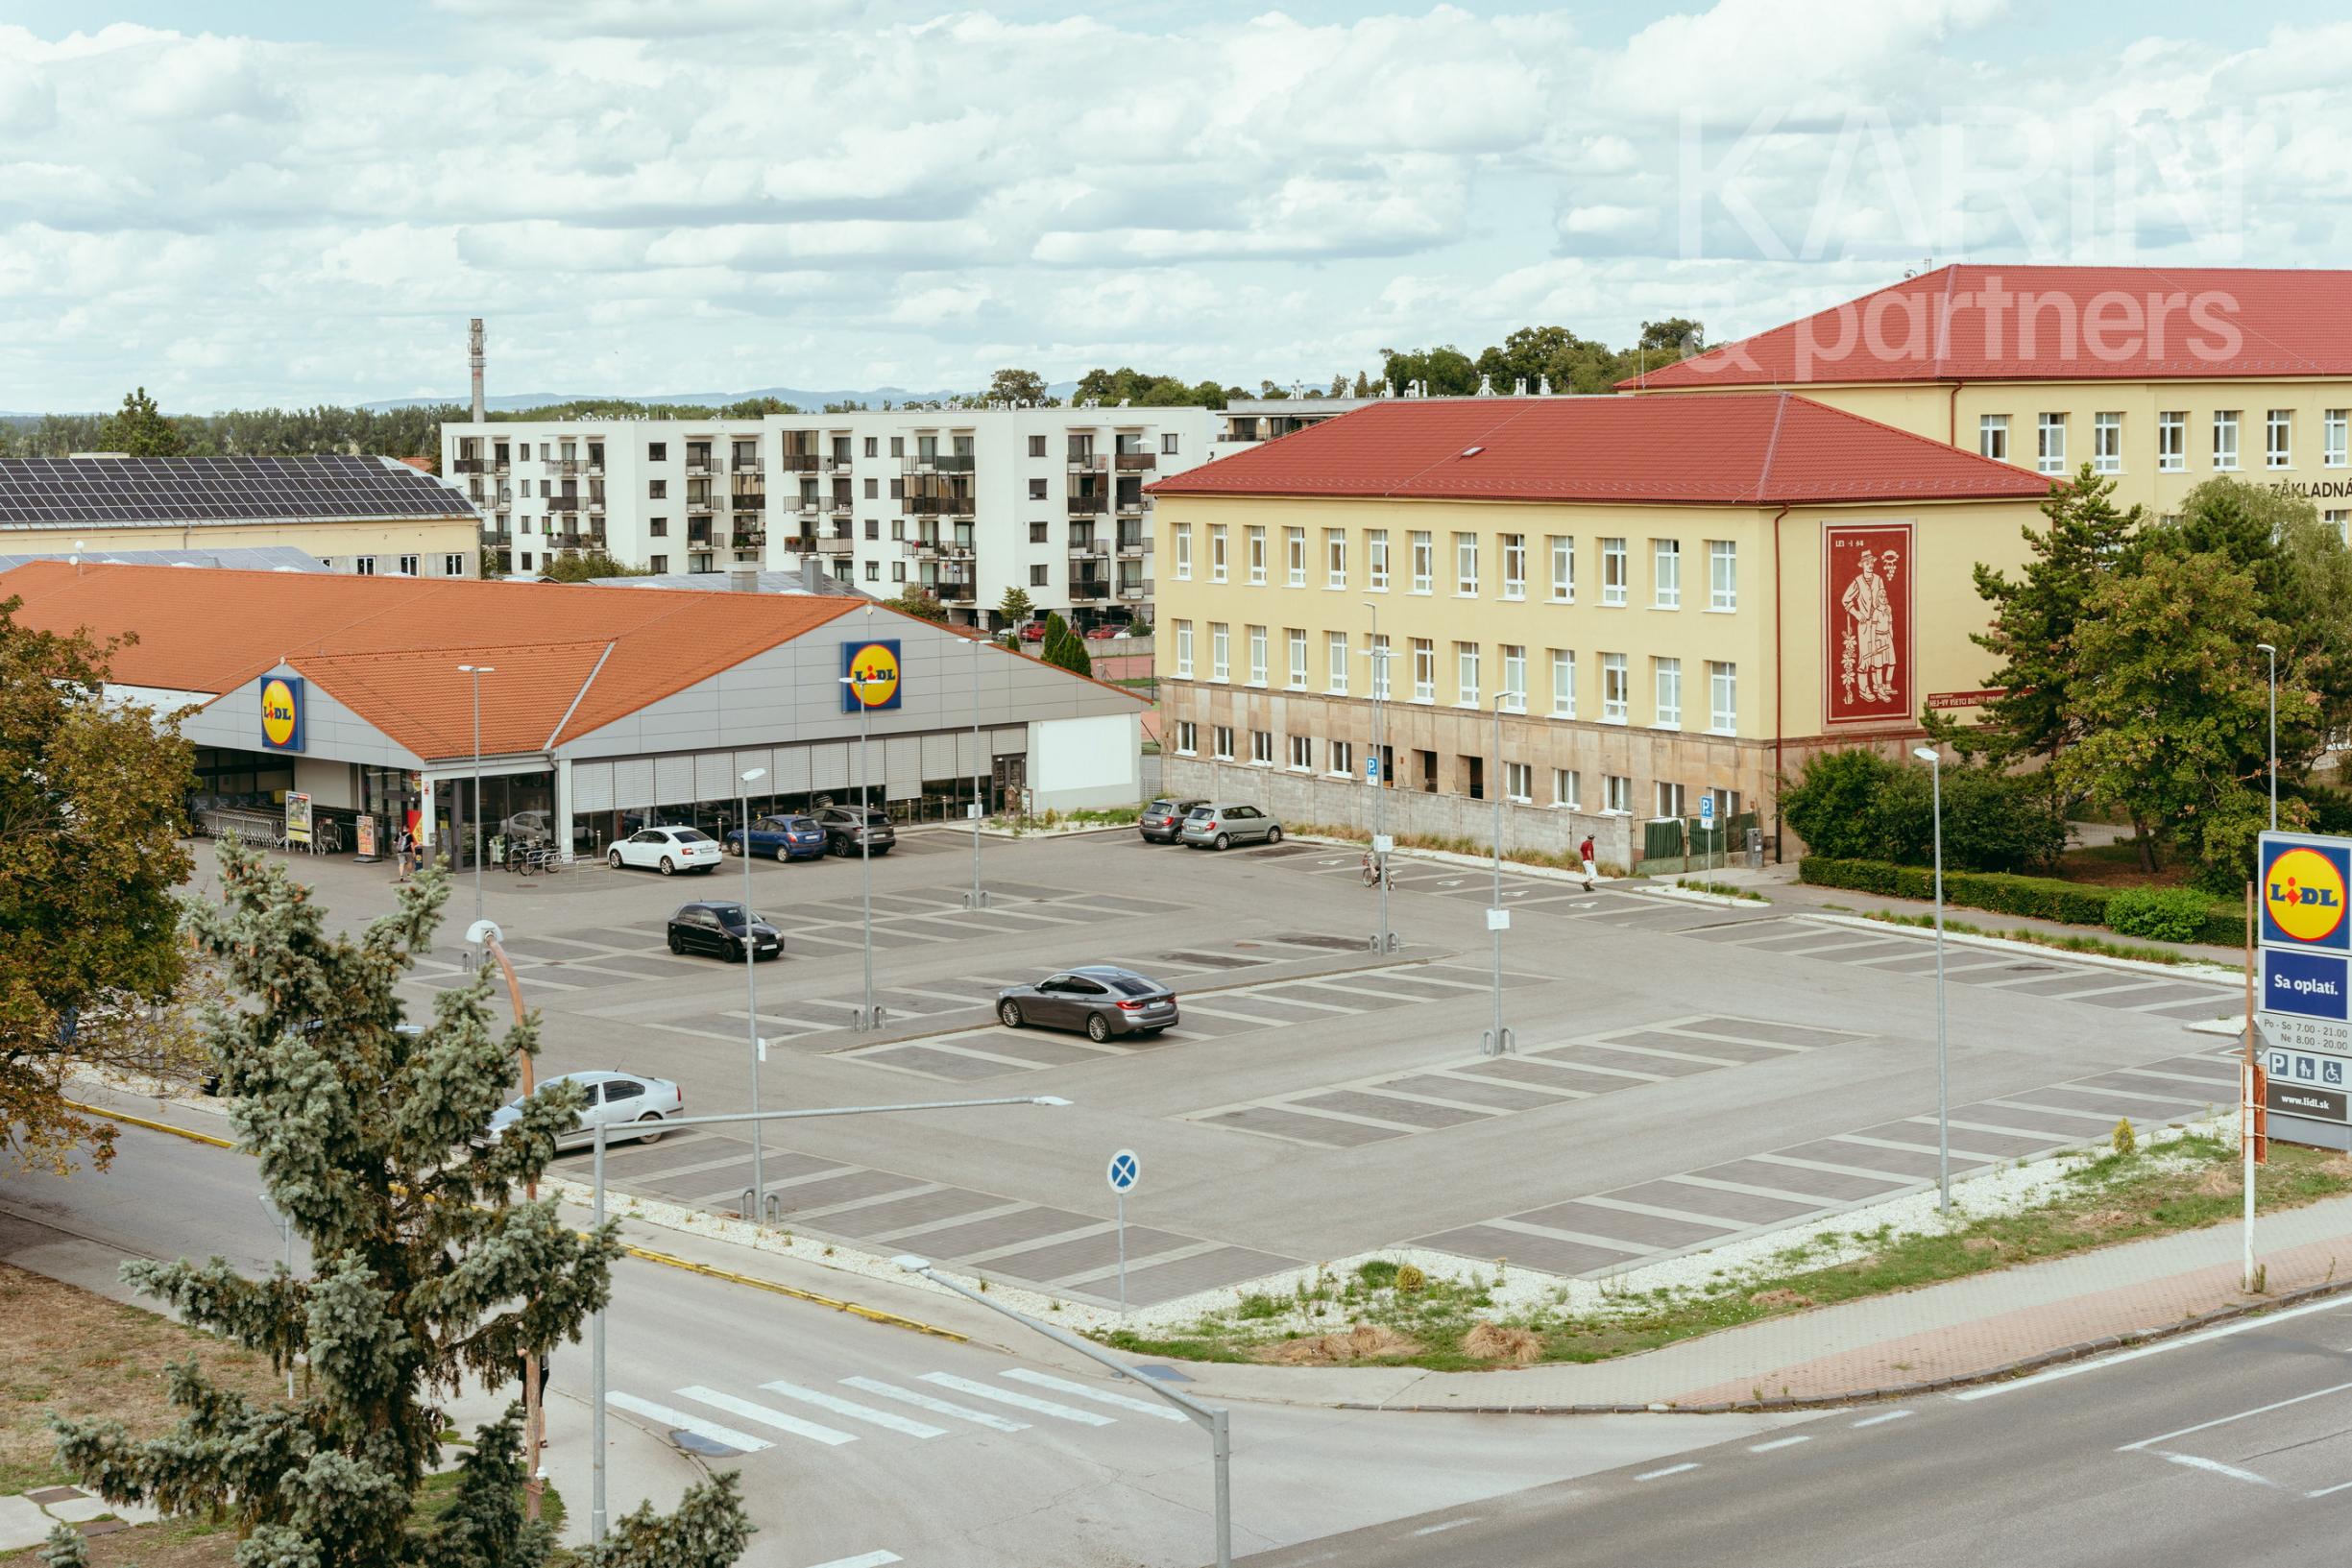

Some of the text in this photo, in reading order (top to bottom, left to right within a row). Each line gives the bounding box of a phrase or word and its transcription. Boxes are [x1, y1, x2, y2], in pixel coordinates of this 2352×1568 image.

[1368, 760, 1376, 774] P
[1703, 800, 1709, 813] P
[2274, 974, 2339, 996] Sa oplatí.
[2264, 1019, 2274, 1028] Po
[2281, 1021, 2291, 1030] So
[2296, 1024, 2316, 1034] 7.00
[2323, 1027, 2348, 1038] 21.00
[2281, 1034, 2291, 1043] Ne
[2295, 1036, 2316, 1046] 8.00
[2323, 1039, 2348, 1050] 20.00
[2271, 1054, 2285, 1073] P
[2281, 1095, 2330, 1110] www.lidl.sk
